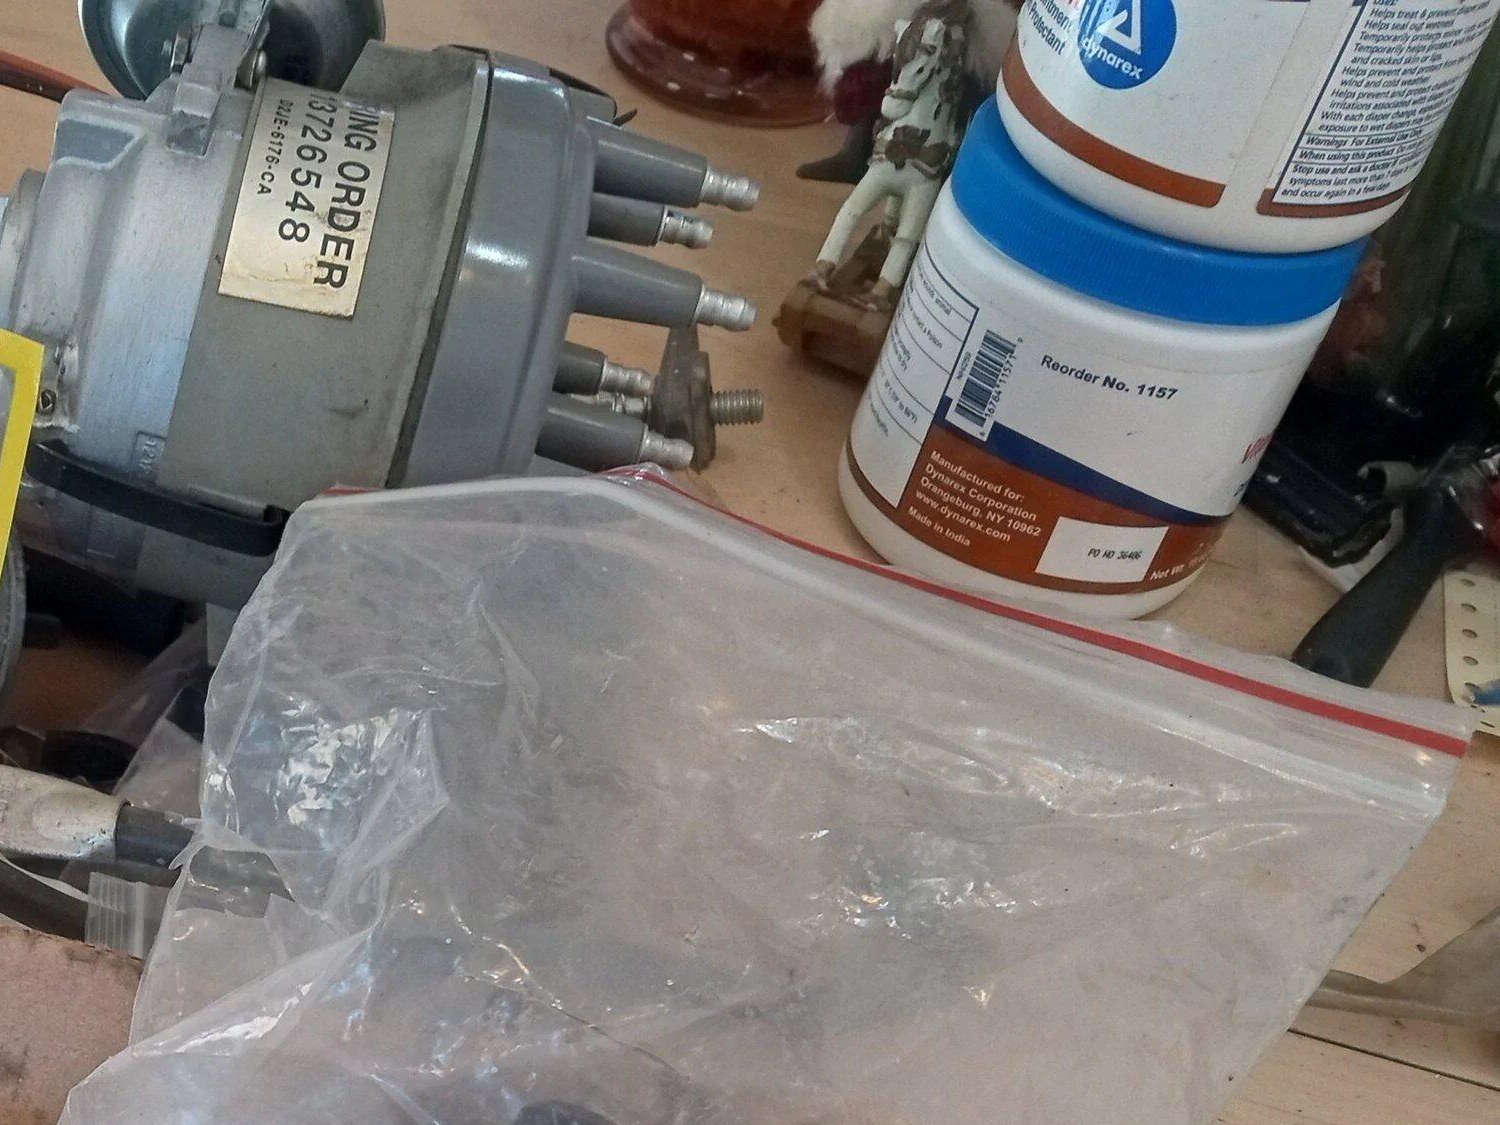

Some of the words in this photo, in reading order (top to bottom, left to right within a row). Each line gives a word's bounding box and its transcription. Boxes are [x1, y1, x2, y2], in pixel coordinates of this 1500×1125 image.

[1370, 8, 1396, 20] Helps
[1029, 1, 1066, 56] Protectant
[1365, 20, 1390, 31] Helps
[1360, 31, 1411, 44] Temporarily
[1354, 43, 1405, 55] Temporarily
[1081, 34, 1144, 80] dynarex
[1342, 66, 1367, 77] Helps
[1366, 68, 1402, 78] prevent
[1340, 78, 1365, 88] wind
[1364, 79, 1382, 87] and
[1331, 88, 1357, 101] Helps
[1355, 90, 1391, 101] prevent
[1321, 111, 1344, 120] With
[1344, 112, 1364, 121] each
[343, 104, 380, 152] ING
[1319, 124, 1358, 133] exposure
[1358, 124, 1369, 132] to
[257, 99, 294, 195] D2JE-6176-CA
[1306, 136, 1348, 148] Warnings
[1300, 150, 1326, 160] When
[1326, 152, 1350, 162] using
[1350, 151, 1366, 160] this
[278, 93, 338, 243] 13726548
[1292, 164, 1314, 176] Stop
[1330, 164, 1349, 174] and
[1289, 177, 1332, 188] symptoms
[1281, 187, 1301, 197] and
[1324, 188, 1347, 199] again
[313, 160, 371, 289] ORDER
[1040, 354, 1100, 384] Reorder
[1102, 375, 1130, 393] No.
[1137, 384, 1178, 400] 1157
[930, 450, 1001, 494] Manufactured
[1003, 485, 1026, 503] for:
[925, 463, 967, 493] Dynarex
[968, 488, 1038, 521] Corporation
[915, 490, 1011, 542] www.dynarex.com
[908, 506, 932, 528] Made
[933, 522, 944, 534] in
[945, 527, 971, 547] India
[986, 511, 1005, 524] NY
[1007, 519, 1042, 537] 10962
